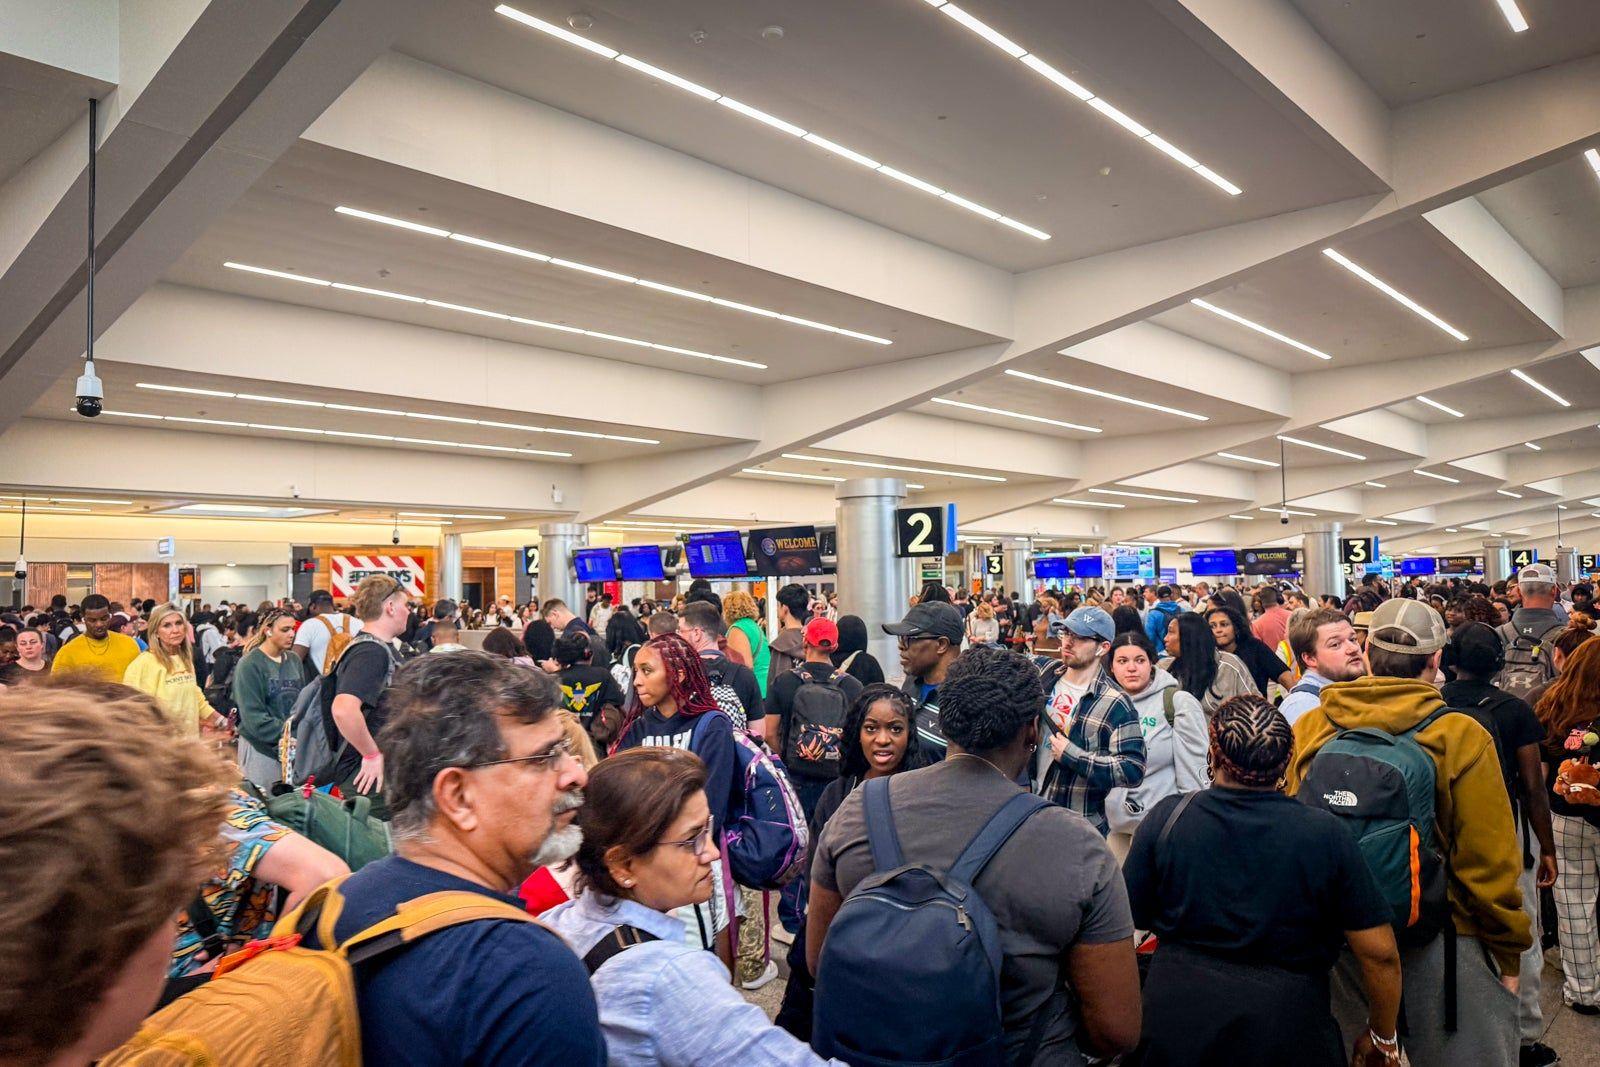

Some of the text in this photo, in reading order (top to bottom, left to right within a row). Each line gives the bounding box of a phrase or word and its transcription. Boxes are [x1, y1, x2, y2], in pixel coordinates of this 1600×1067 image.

[907, 512, 934, 553] 2
[776, 537, 817, 550] WELCOME
[1349, 540, 1366, 562] 3
[527, 548, 540, 573] 2
[988, 556, 1001, 574] 3
[1515, 551, 1530, 566] 4
[1583, 556, 1594, 568] 5
[1343, 564, 1352, 574] 5
[1323, 793, 1348, 801] NORTH
